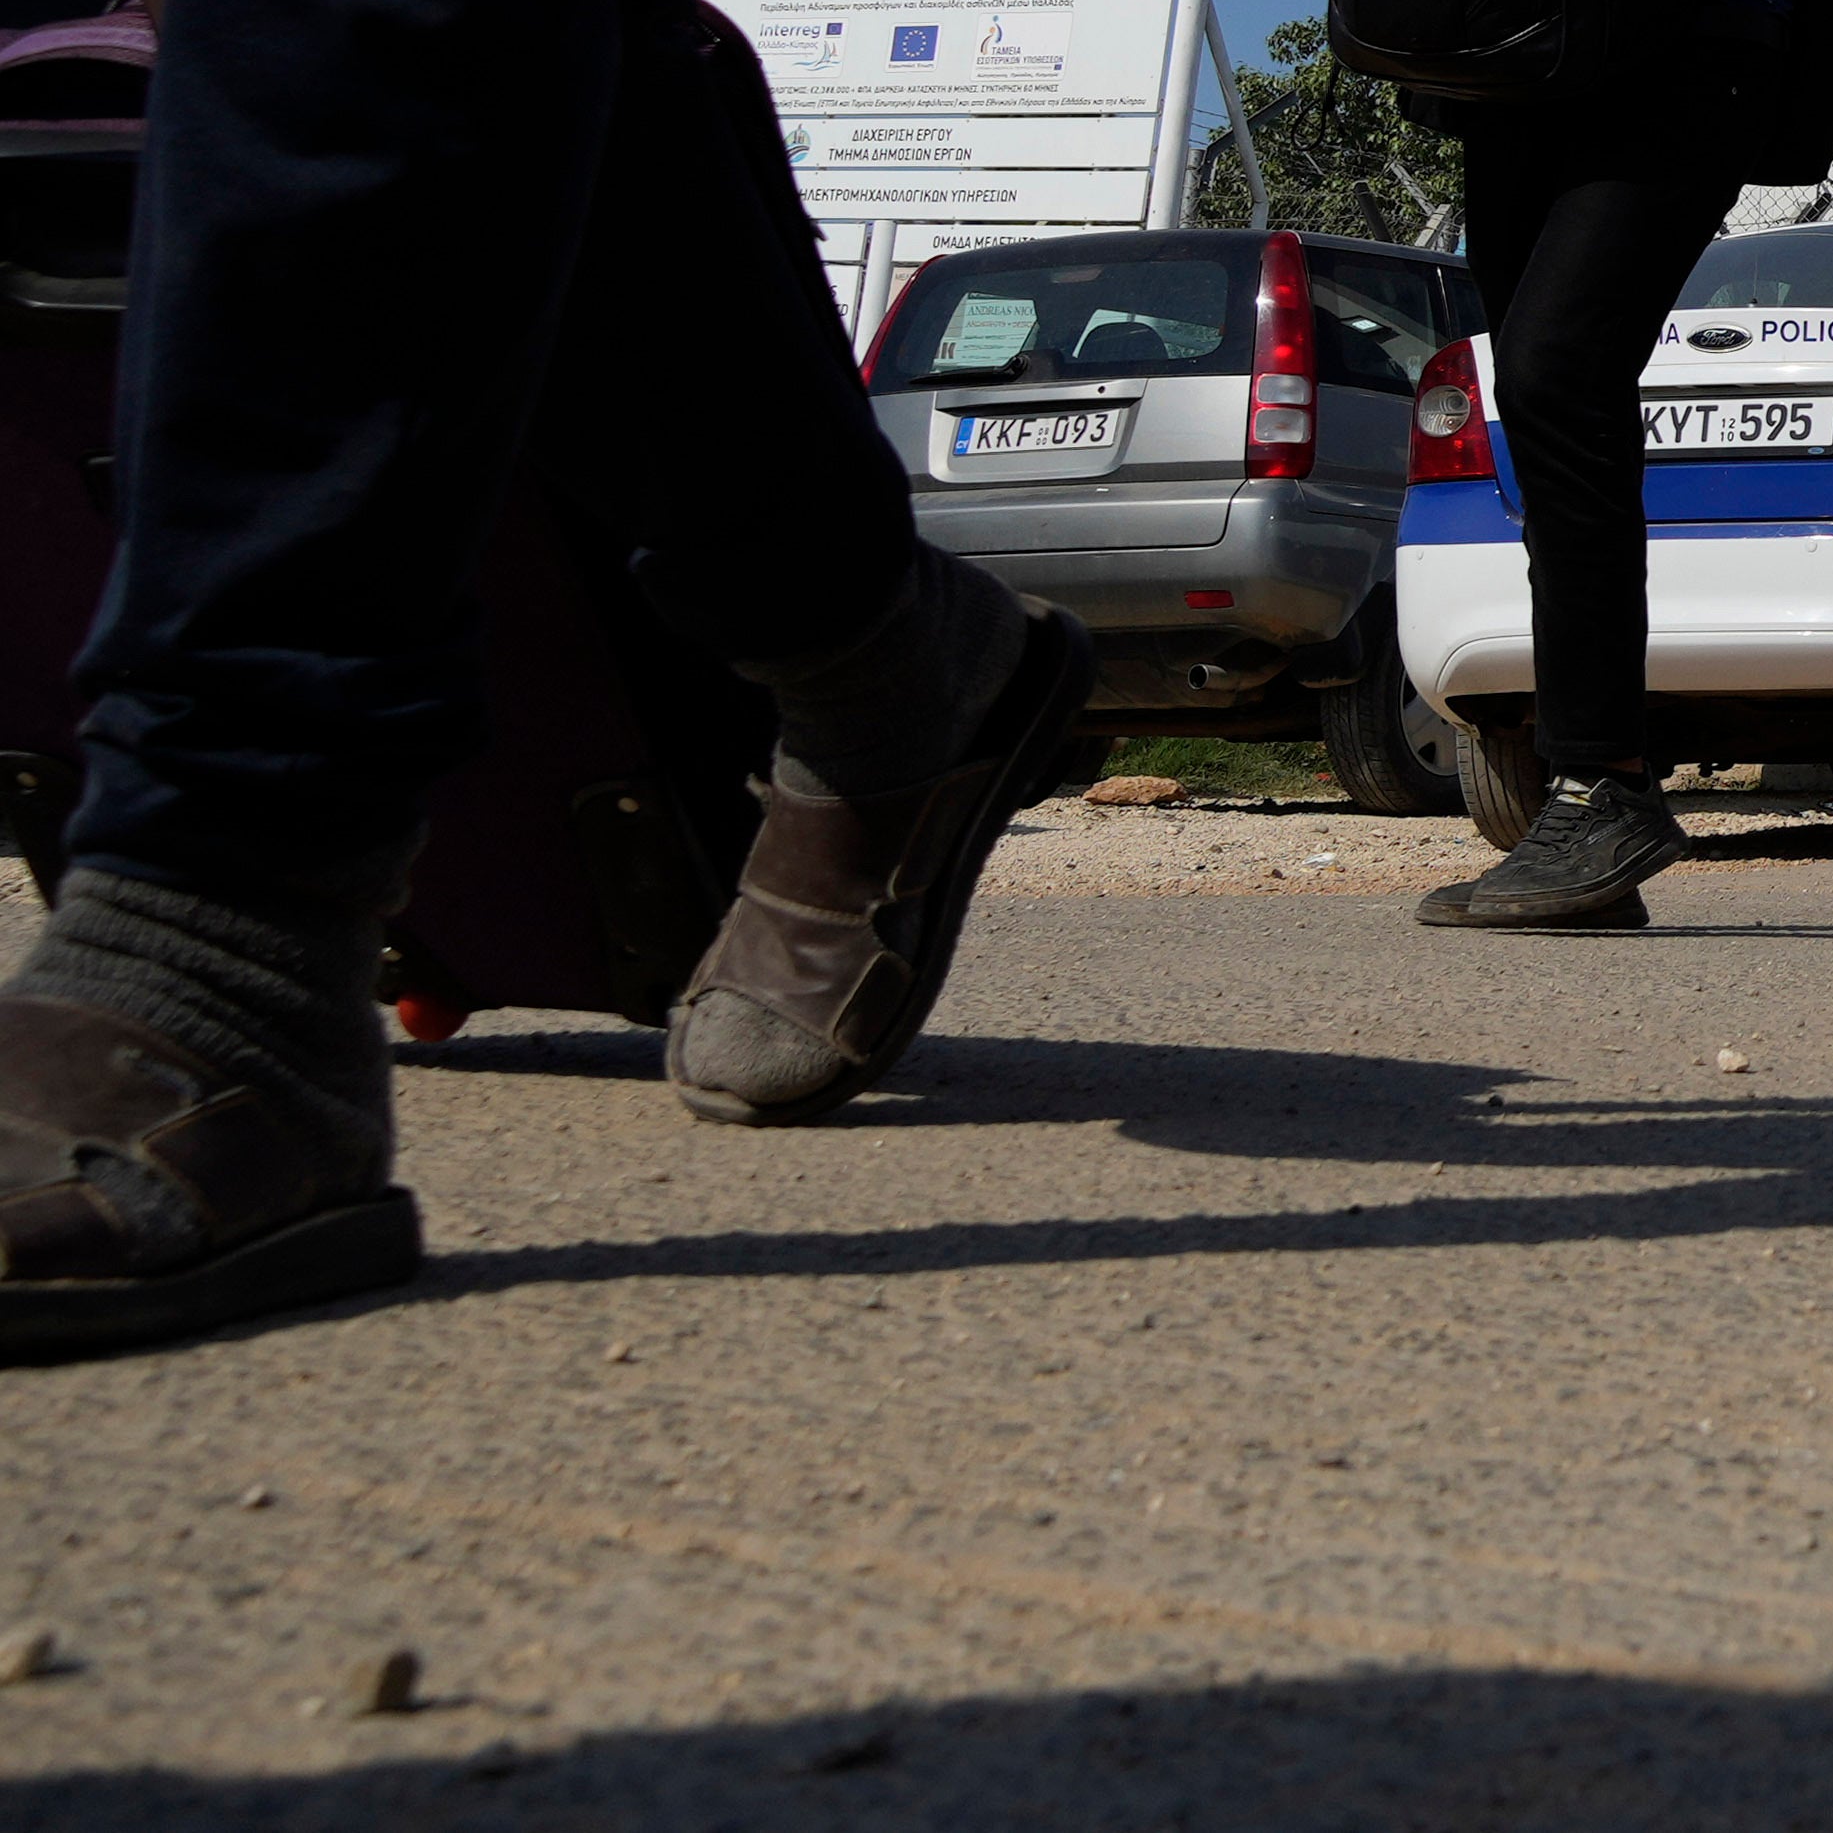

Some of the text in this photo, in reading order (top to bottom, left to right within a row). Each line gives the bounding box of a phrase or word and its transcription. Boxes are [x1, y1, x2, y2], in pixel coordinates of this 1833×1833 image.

[760, 23, 821, 38] Interreg
[991, 46, 1021, 55] ΤΑΜΕΙΑ
[852, 128, 954, 142] ΔΙΑΧΕΙΡΙΣΗ ΕΡΓΟΥ
[828, 148, 972, 161] ΤΜΗΜΑ ΔΗΜΟΣΙΩΝ ΕΡΓΩΝ
[951, 189, 1018, 203] ΥΠΗΡΕΣΙΩΝ
[932, 235, 971, 249] ΟΜΑΔΑ
[1700, 328, 1735, 346] Ford
[1721, 417, 1736, 429] 12
[1739, 403, 1814, 441] 595
[976, 414, 1109, 449] KKF 093
[1720, 430, 1735, 442] 10
